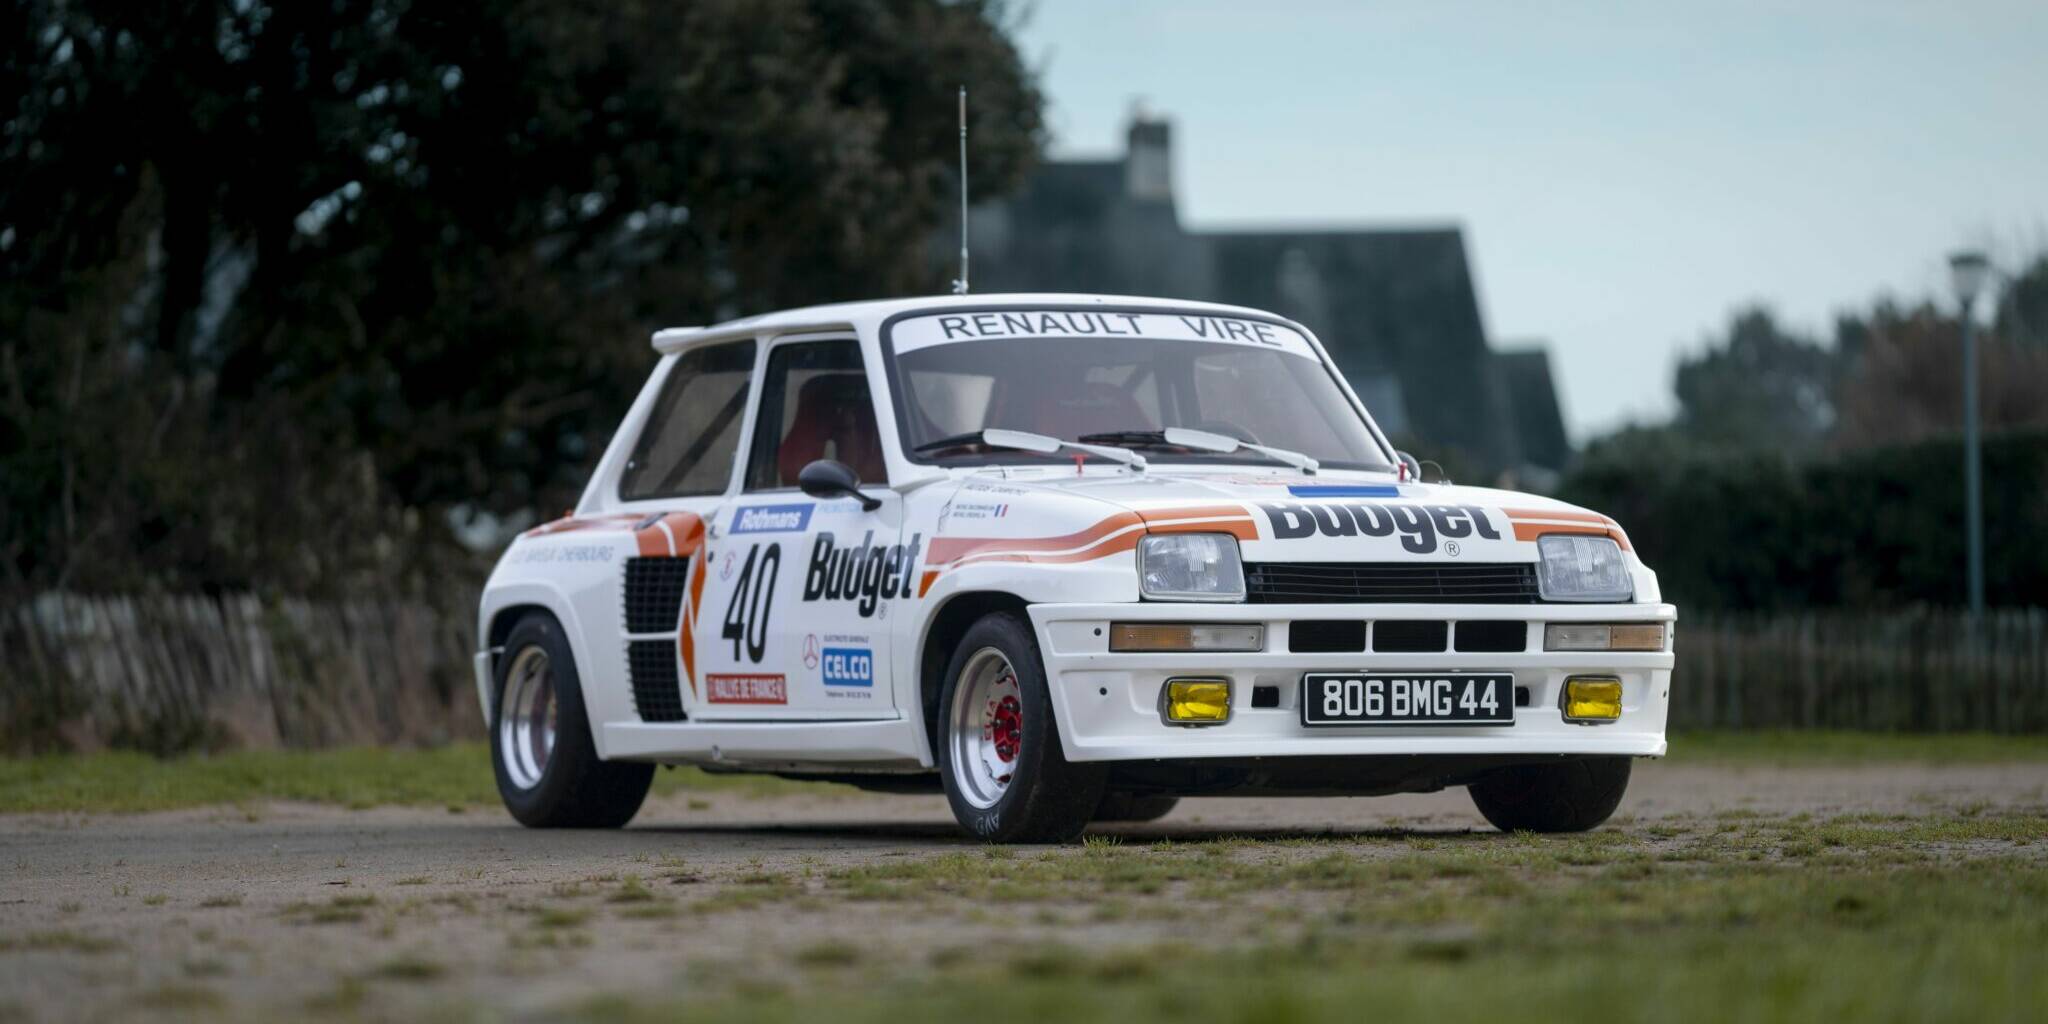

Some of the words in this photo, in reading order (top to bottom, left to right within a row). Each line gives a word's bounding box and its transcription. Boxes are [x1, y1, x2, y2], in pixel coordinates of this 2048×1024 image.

[938, 312, 1146, 340] RENAULT
[1179, 316, 1283, 347] VIRE
[739, 508, 803, 531] Rothmans
[802, 530, 922, 619] Budget
[722, 542, 781, 664] 40
[824, 654, 870, 681] CELCO
[715, 679, 739, 698] RALLYE
[740, 679, 750, 698] DE
[751, 679, 776, 698] FRANCE
[1323, 679, 1384, 716] 806
[1391, 679, 1452, 716] BMG
[1459, 679, 1499, 716] 44
